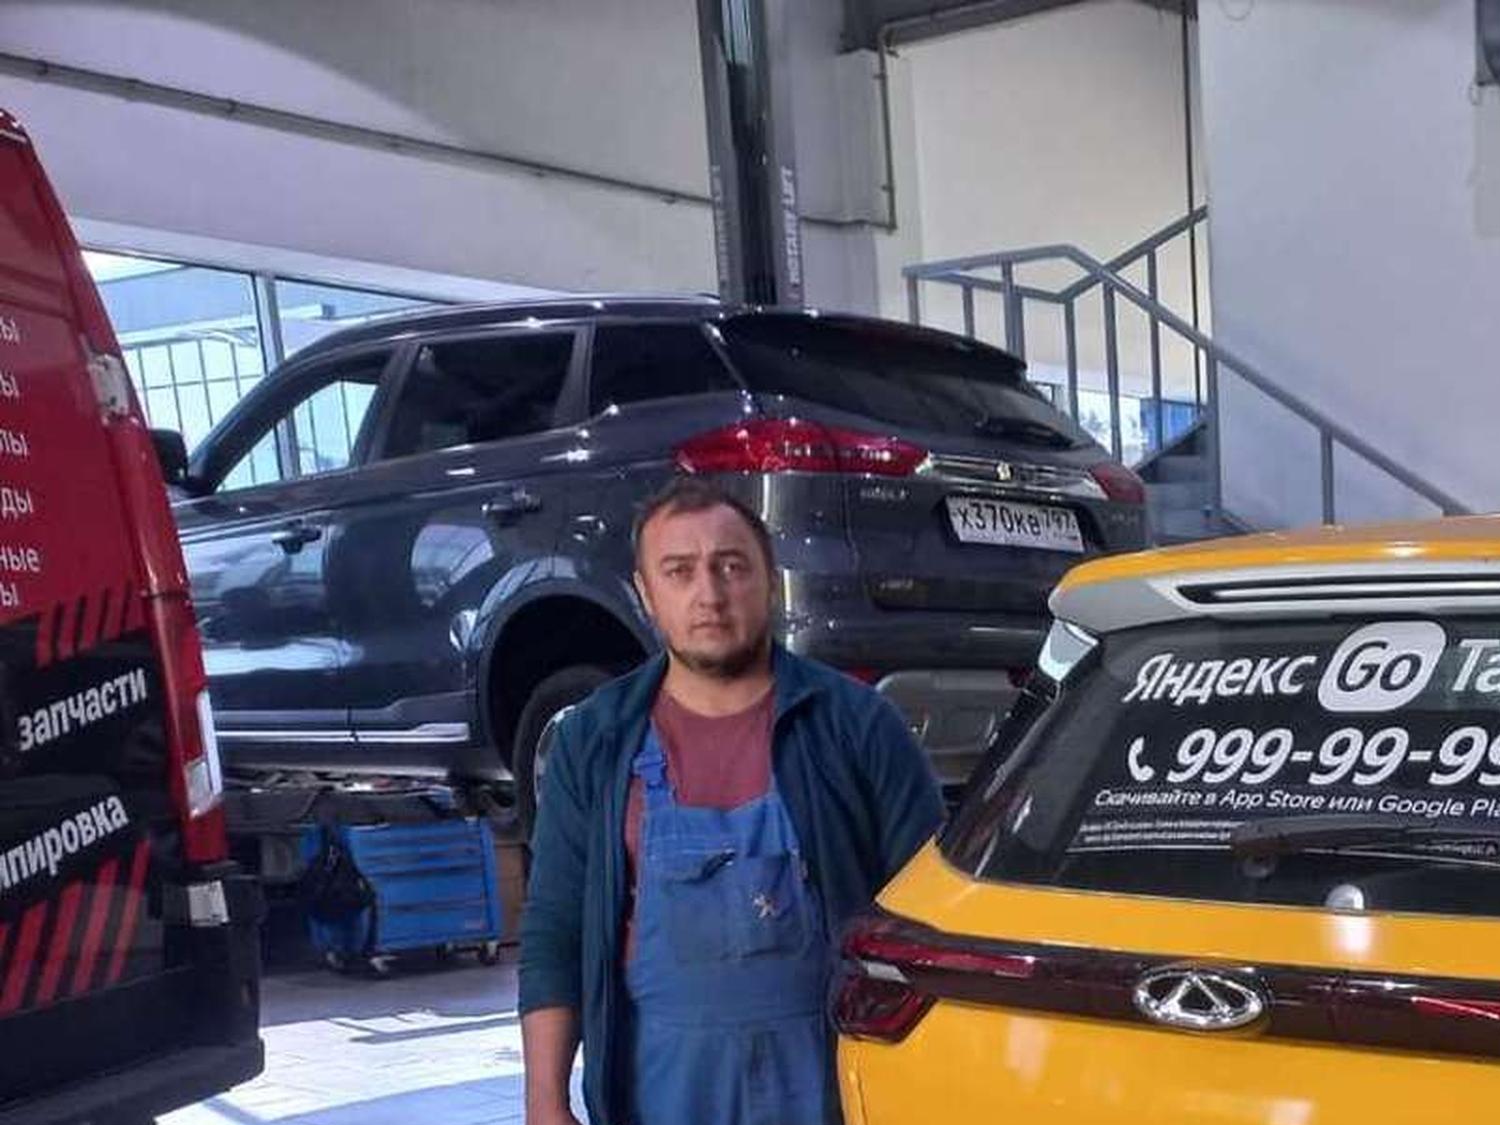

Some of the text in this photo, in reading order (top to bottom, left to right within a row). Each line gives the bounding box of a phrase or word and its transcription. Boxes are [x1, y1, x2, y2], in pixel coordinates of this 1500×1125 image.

[1124, 653, 1317, 704] Яндекс
[1337, 639, 1422, 692] Go
[18, 667, 147, 752] запчасти
[1094, 789, 1201, 807] Скачивайте
[1219, 788, 1263, 810] App
[1265, 789, 1326, 809] Store
[1328, 795, 1374, 812] или
[1378, 794, 1466, 819] Google
